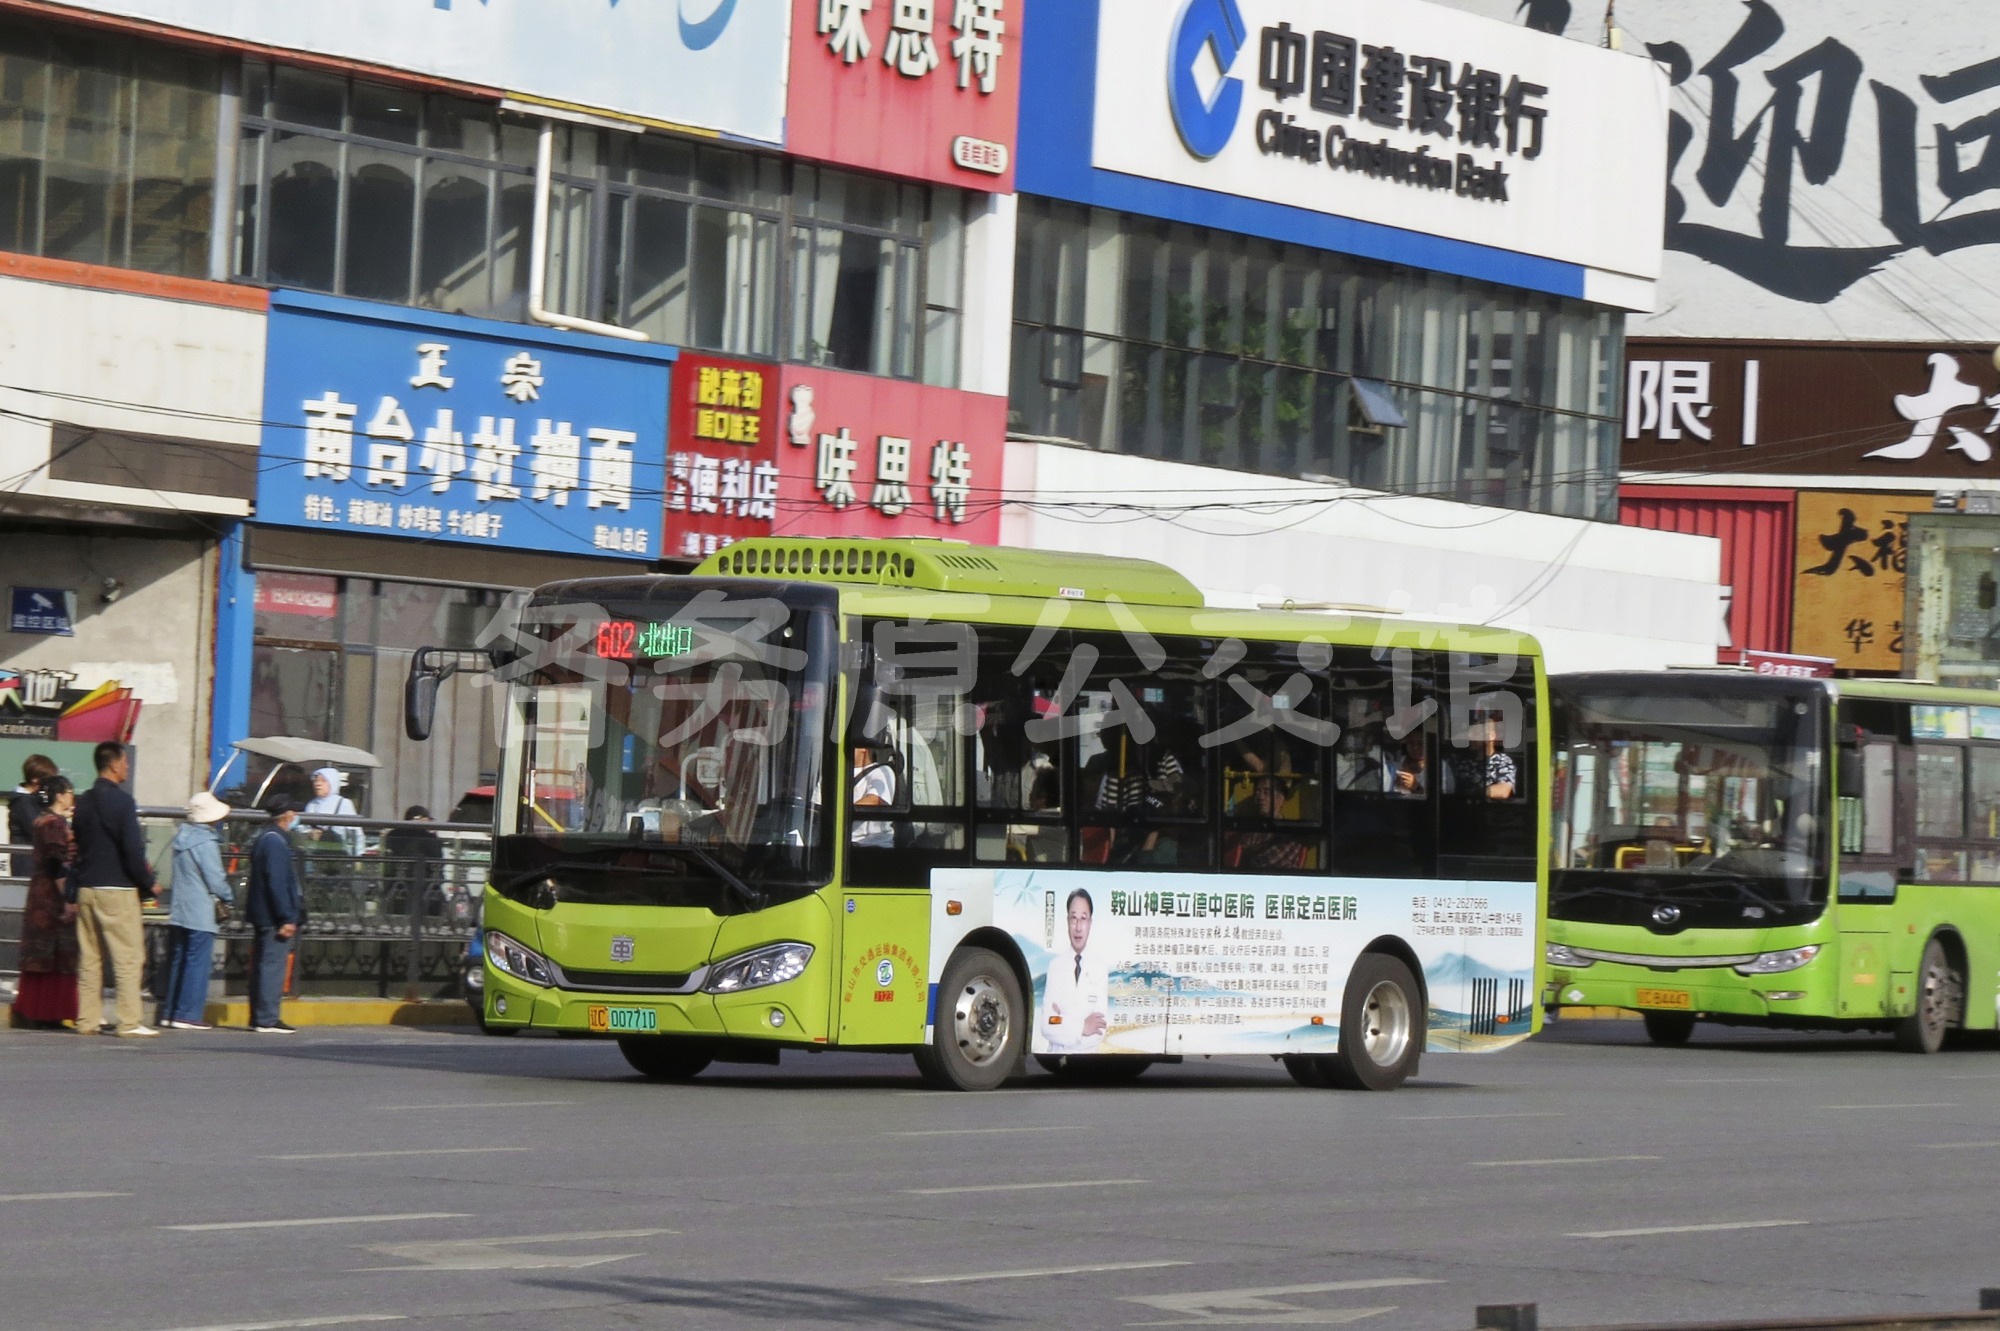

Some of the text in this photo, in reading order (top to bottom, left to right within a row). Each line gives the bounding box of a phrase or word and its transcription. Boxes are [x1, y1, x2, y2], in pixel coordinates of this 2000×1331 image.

[818, 0, 1004, 95] 味思特
[1259, 21, 1548, 161] 中国建设银行
[1256, 109, 1509, 202] China Construction Bank
[409, 342, 544, 402] 正宗
[1862, 353, 2000, 462] 大
[689, 453, 780, 519] 便利店
[815, 427, 972, 525] 味思特
[597, 621, 692, 659] 602 北出口
[1111, 890, 1357, 921] 鞍山神草立德中医院 医保定点医院
